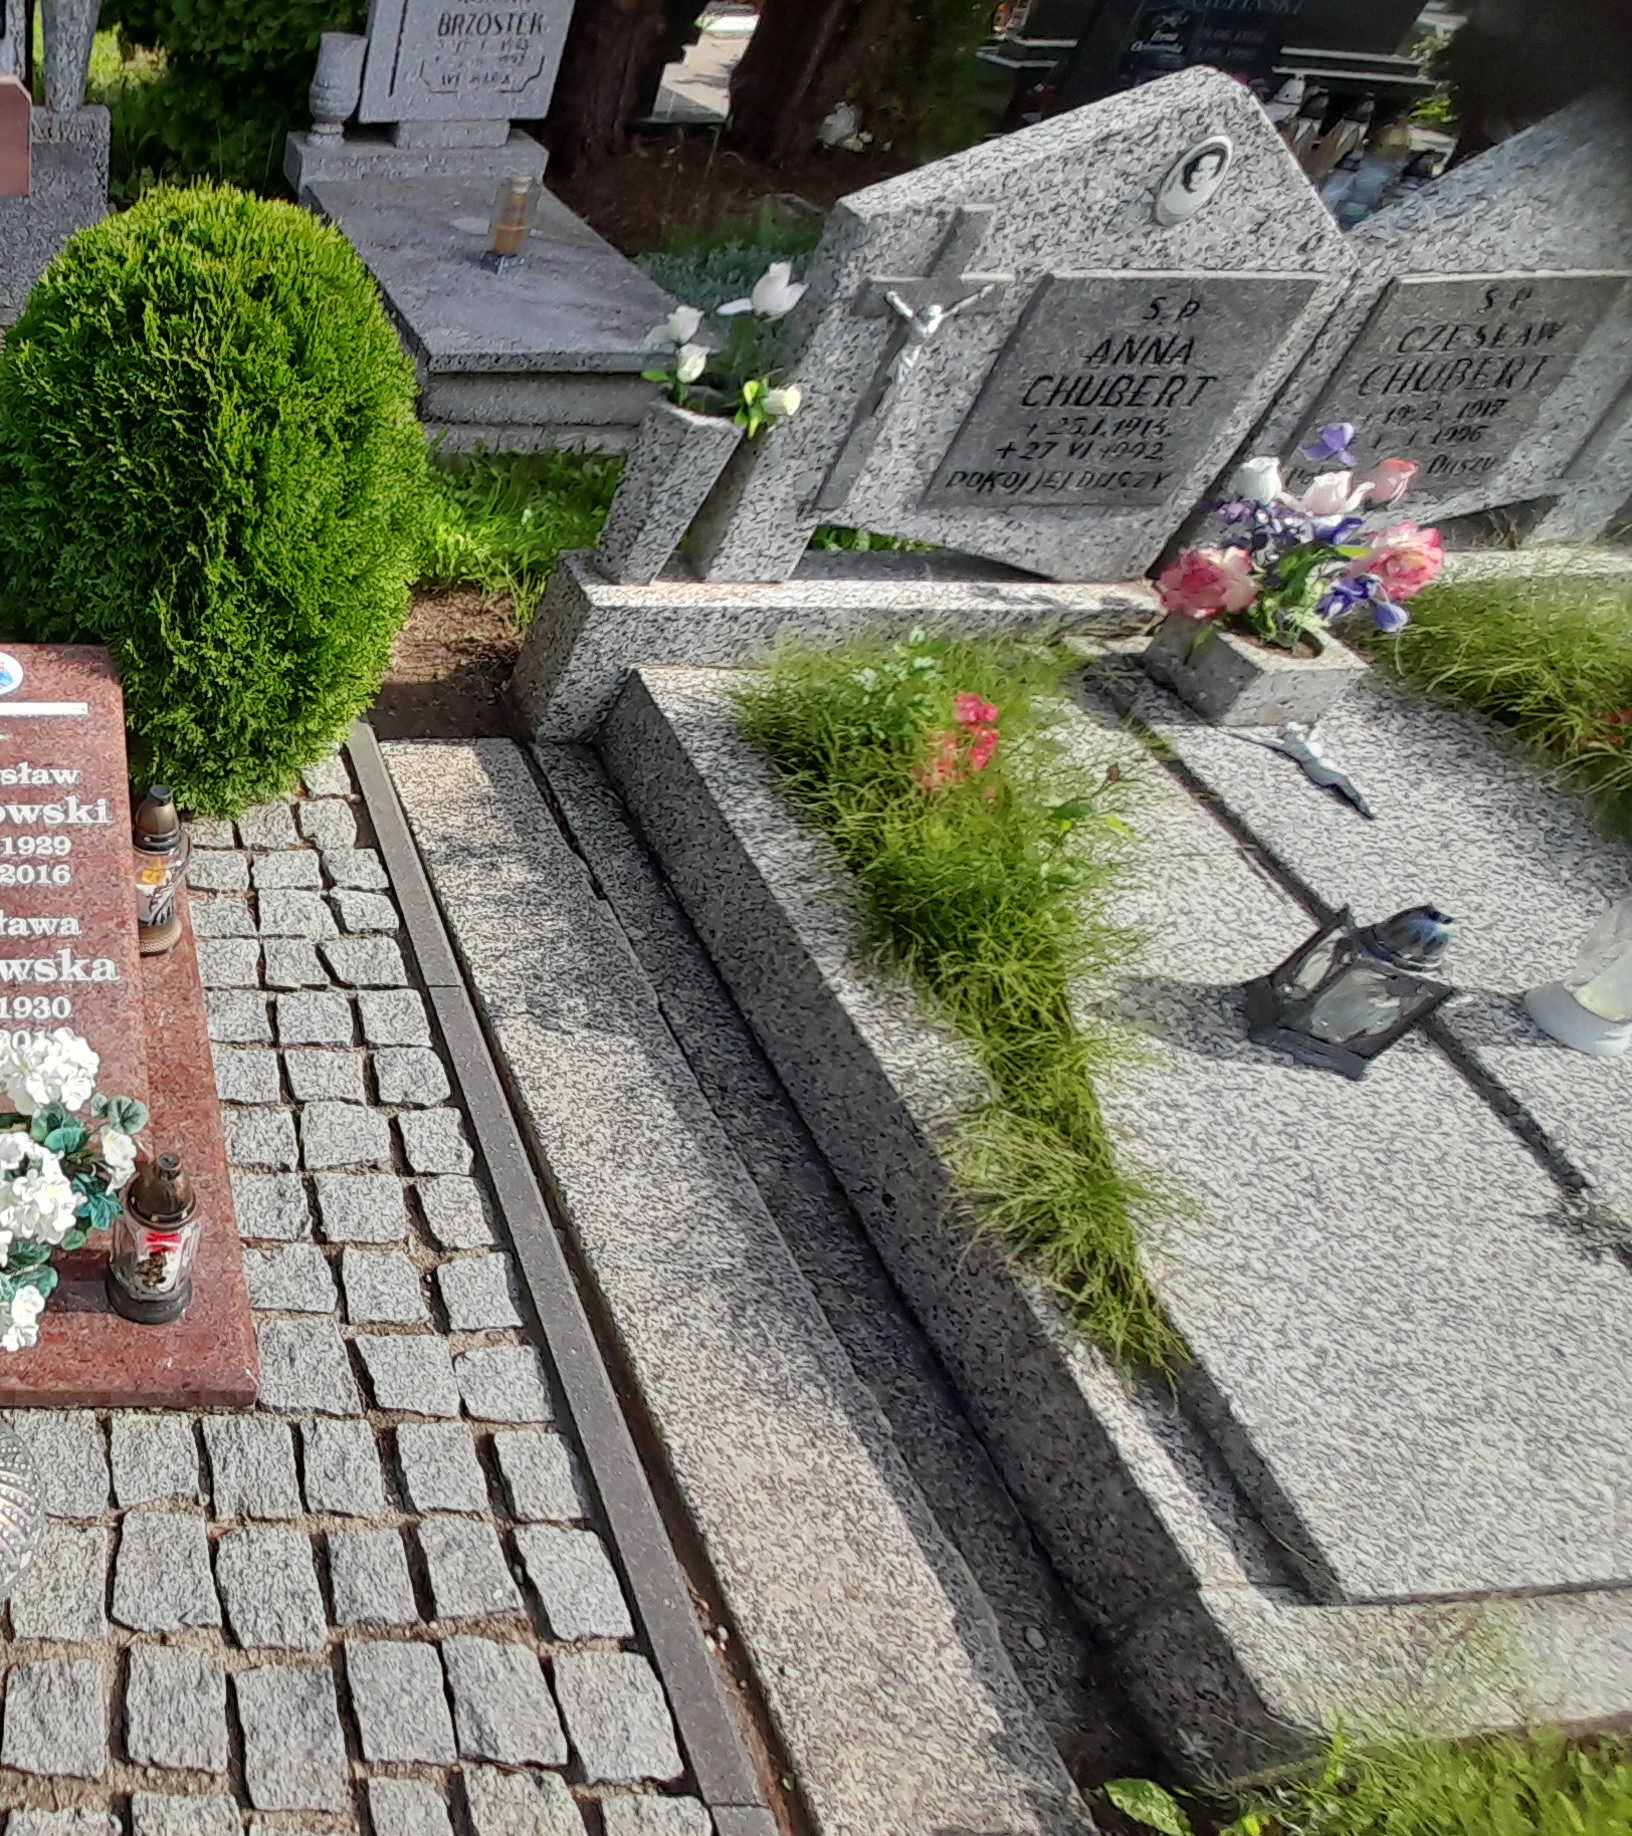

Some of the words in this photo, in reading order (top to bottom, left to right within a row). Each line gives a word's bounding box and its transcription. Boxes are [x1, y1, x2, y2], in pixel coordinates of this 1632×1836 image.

[437, 12, 544, 37] BRZOSTEK
[1085, 335, 1196, 365] ANNA
[1397, 320, 1566, 353] CZESŁAW
[1358, 355, 1555, 396] CHUBERT
[1020, 375, 1218, 407] CHUBERT
[1019, 441, 1058, 460] 27
[1076, 470, 1173, 491] DUSZY
